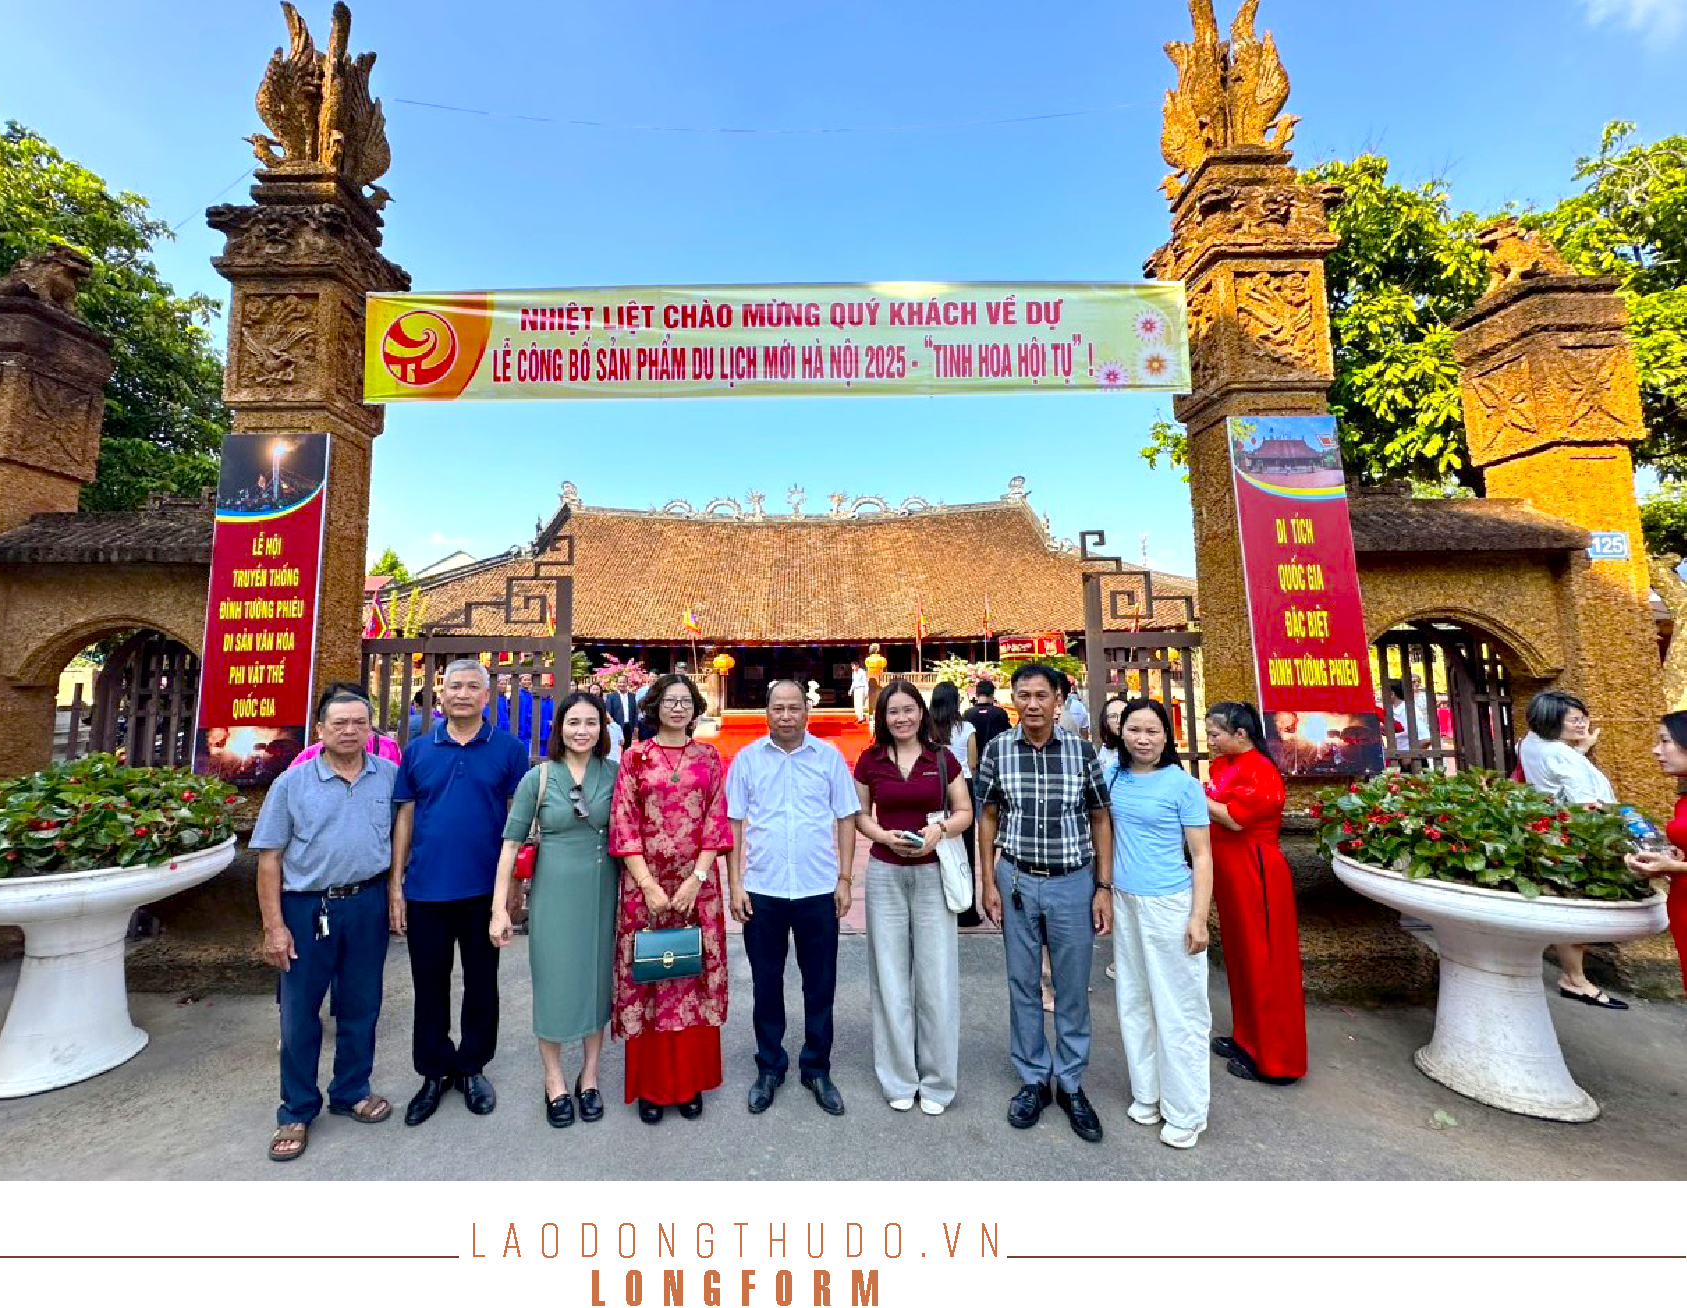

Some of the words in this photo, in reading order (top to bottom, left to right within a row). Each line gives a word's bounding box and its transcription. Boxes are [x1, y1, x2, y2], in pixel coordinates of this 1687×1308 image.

[520, 302, 594, 335] NHIỆT
[602, 300, 655, 334] LIỆT
[663, 299, 733, 328] CHÀO
[742, 298, 820, 328] MỪNG
[830, 298, 880, 330] QUÝ
[889, 298, 977, 326] KHÁCH
[1025, 299, 1064, 330] DỰ
[493, 337, 512, 382] LỄ
[517, 342, 564, 382] CÔNG
[569, 336, 591, 382] BỐ
[596, 336, 631, 381] SẢN
[637, 333, 687, 381] PHẨM
[692, 347, 714, 380] DU
[719, 345, 758, 388] LỊCH
[763, 338, 796, 380] MỚI
[801, 338, 824, 379] HÀ
[829, 338, 859, 387] NỘI
[865, 344, 906, 379] 2025
[978, 342, 1012, 378] HOA
[1018, 336, 1047, 385] HỘI
[265, 533, 282, 559] HỘI
[1290, 512, 1315, 545] TÍCH
[1591, 536, 1623, 553] 125
[1278, 554, 1306, 593] QUỐC
[1306, 563, 1325, 591] GIA
[1306, 604, 1330, 644] BIỆT
[232, 691, 259, 721] QUỐC
[259, 697, 277, 718] GIA
